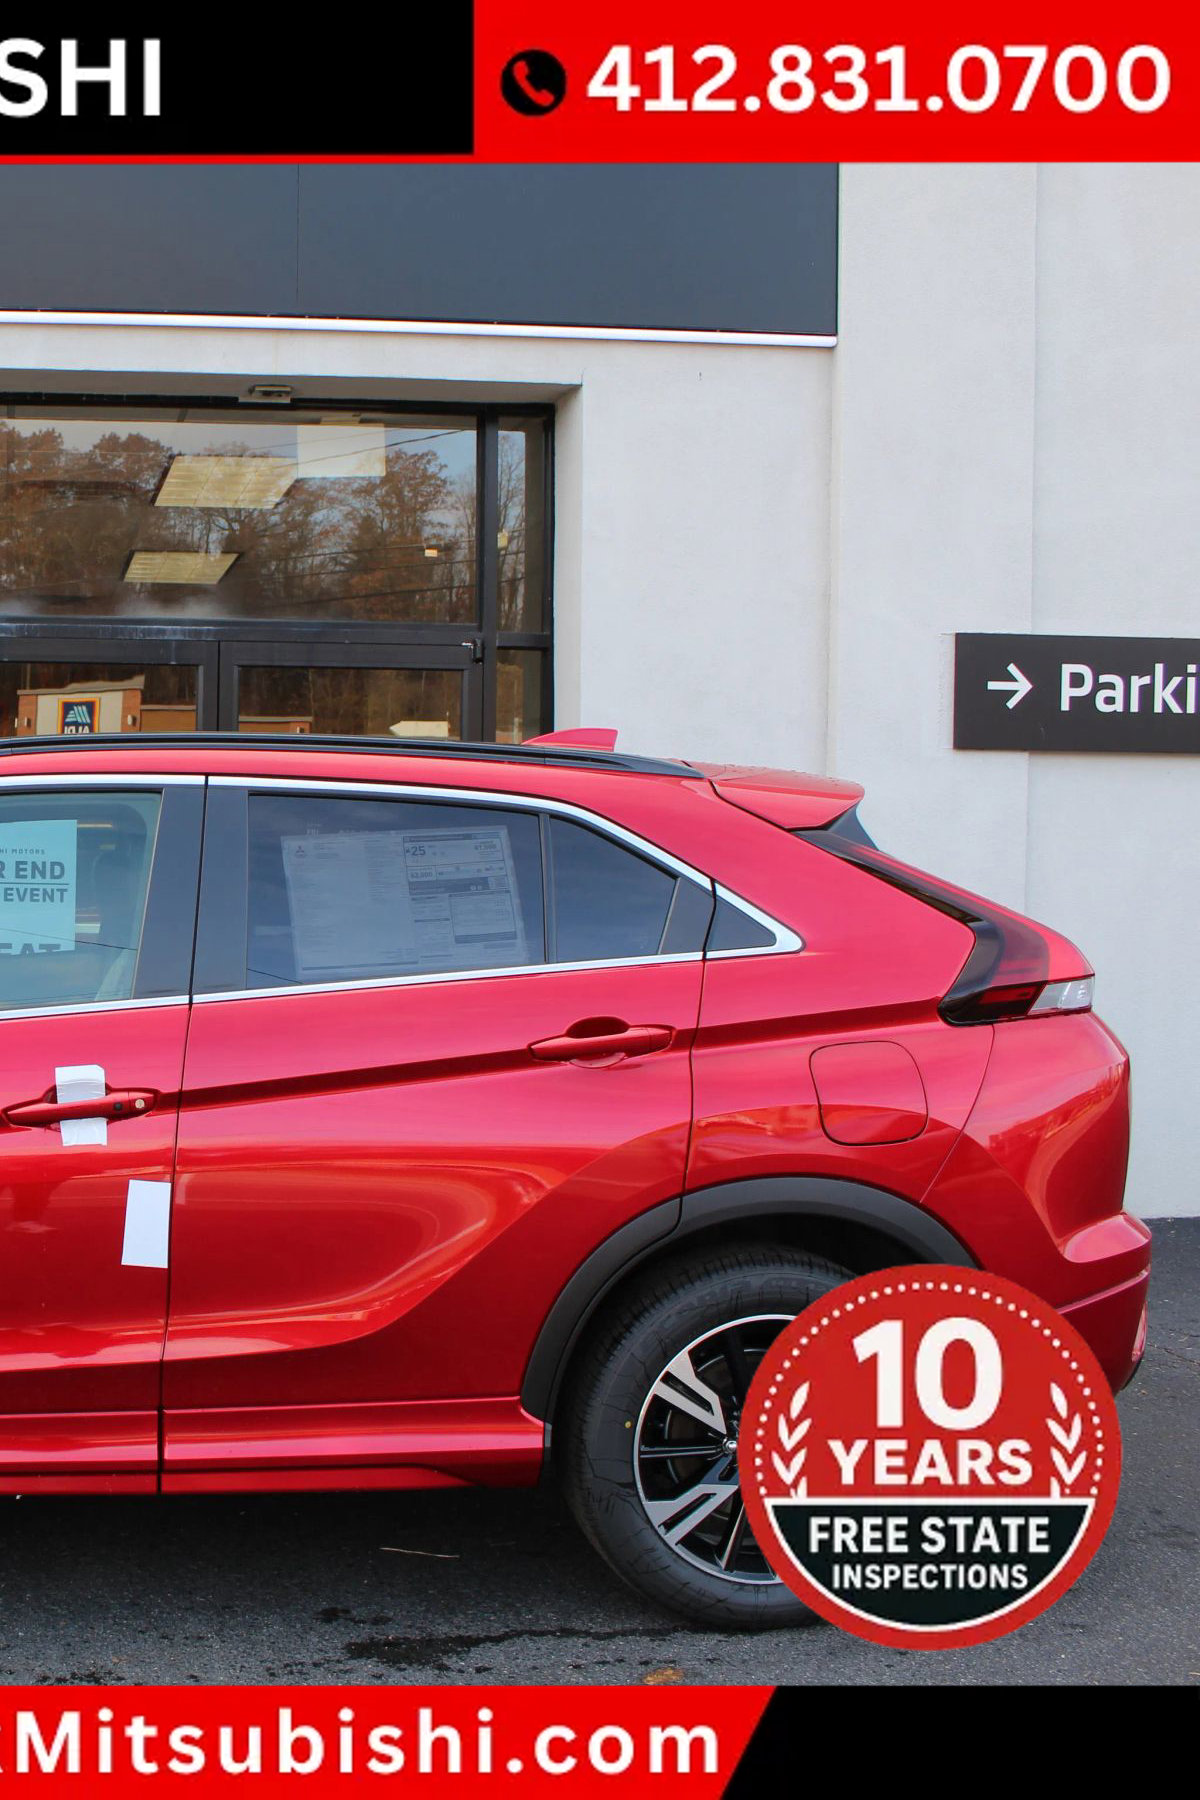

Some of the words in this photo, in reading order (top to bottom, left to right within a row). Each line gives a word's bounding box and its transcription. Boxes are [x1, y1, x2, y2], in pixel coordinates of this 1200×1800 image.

[1061, 663, 1196, 714] Parki
[410, 845, 426, 856] 25
[15, 860, 65, 880] END
[3, 887, 68, 903] EVENT
